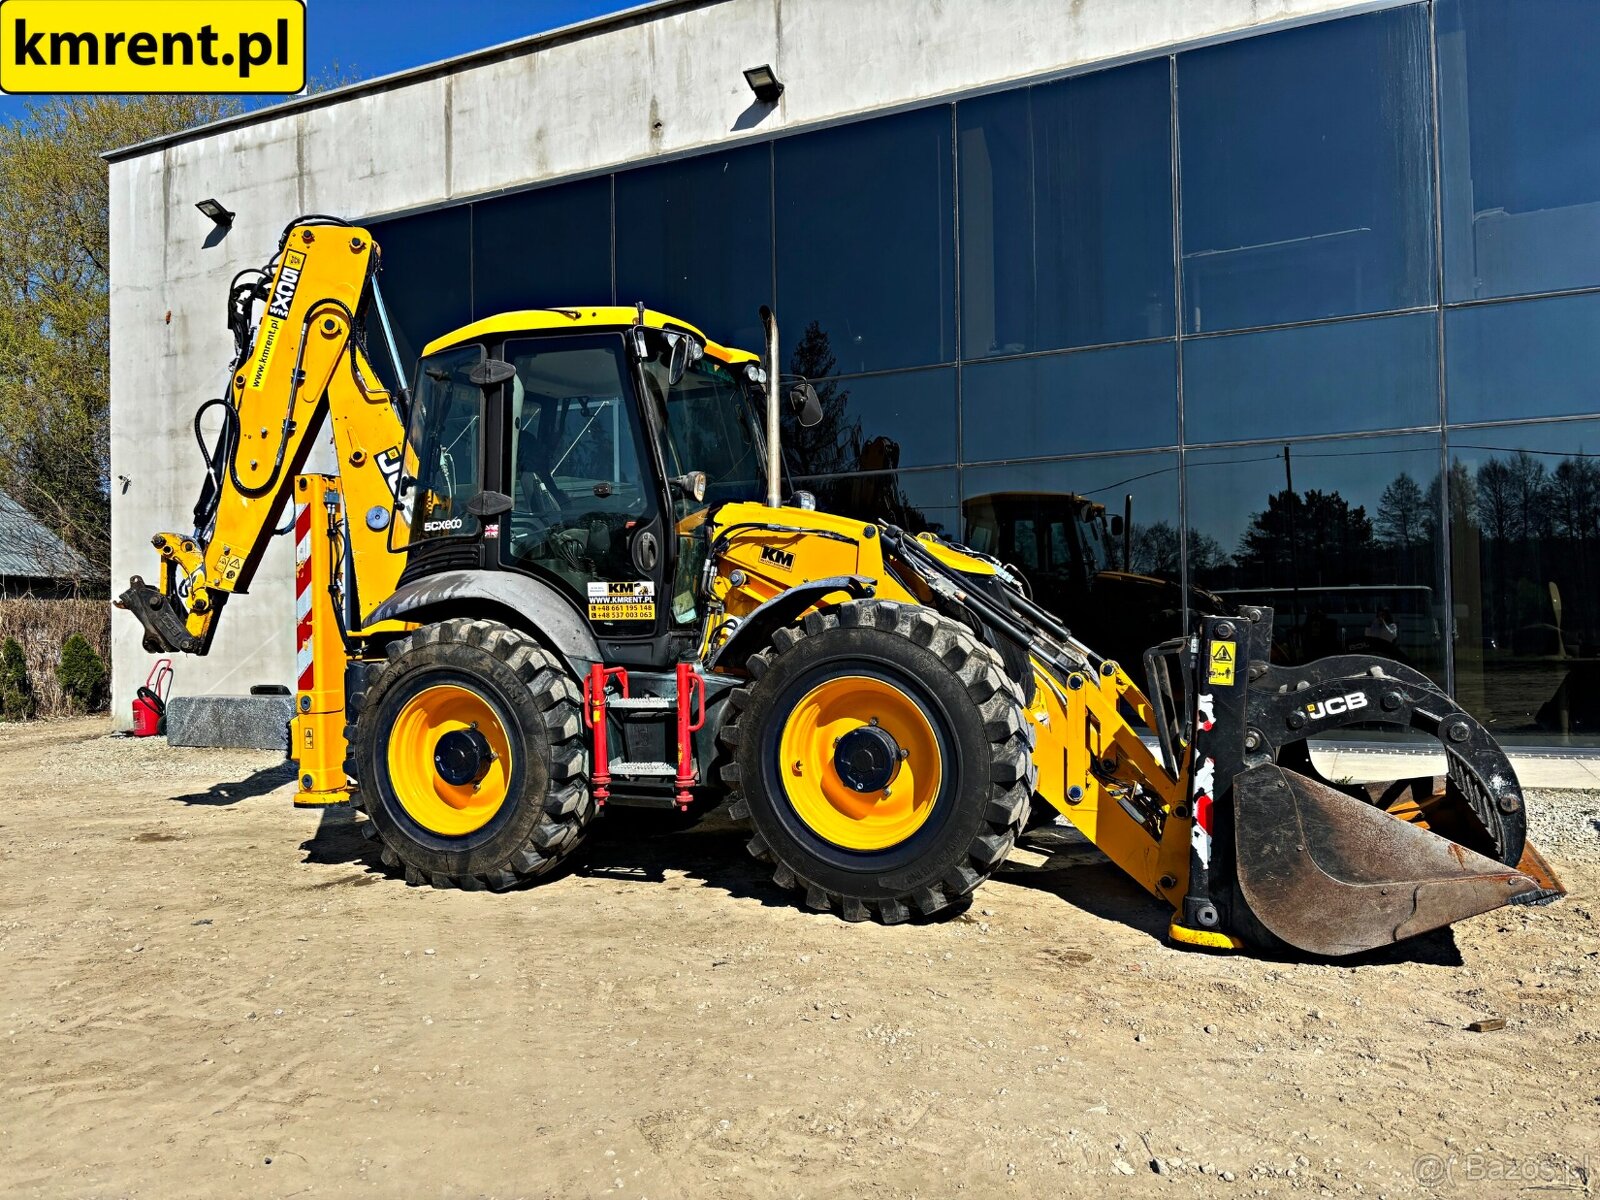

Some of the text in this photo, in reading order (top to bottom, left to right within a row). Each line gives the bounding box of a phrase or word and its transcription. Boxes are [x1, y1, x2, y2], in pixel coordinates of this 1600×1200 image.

[271, 267, 299, 311] 5CX
[269, 306, 289, 317] WM
[252, 319, 279, 387] www.kmrent.pl
[760, 545, 794, 567] KM
[608, 583, 634, 593] KM
[589, 596, 654, 604] WWW.KMRENT.PL
[1308, 691, 1368, 720] JCB
